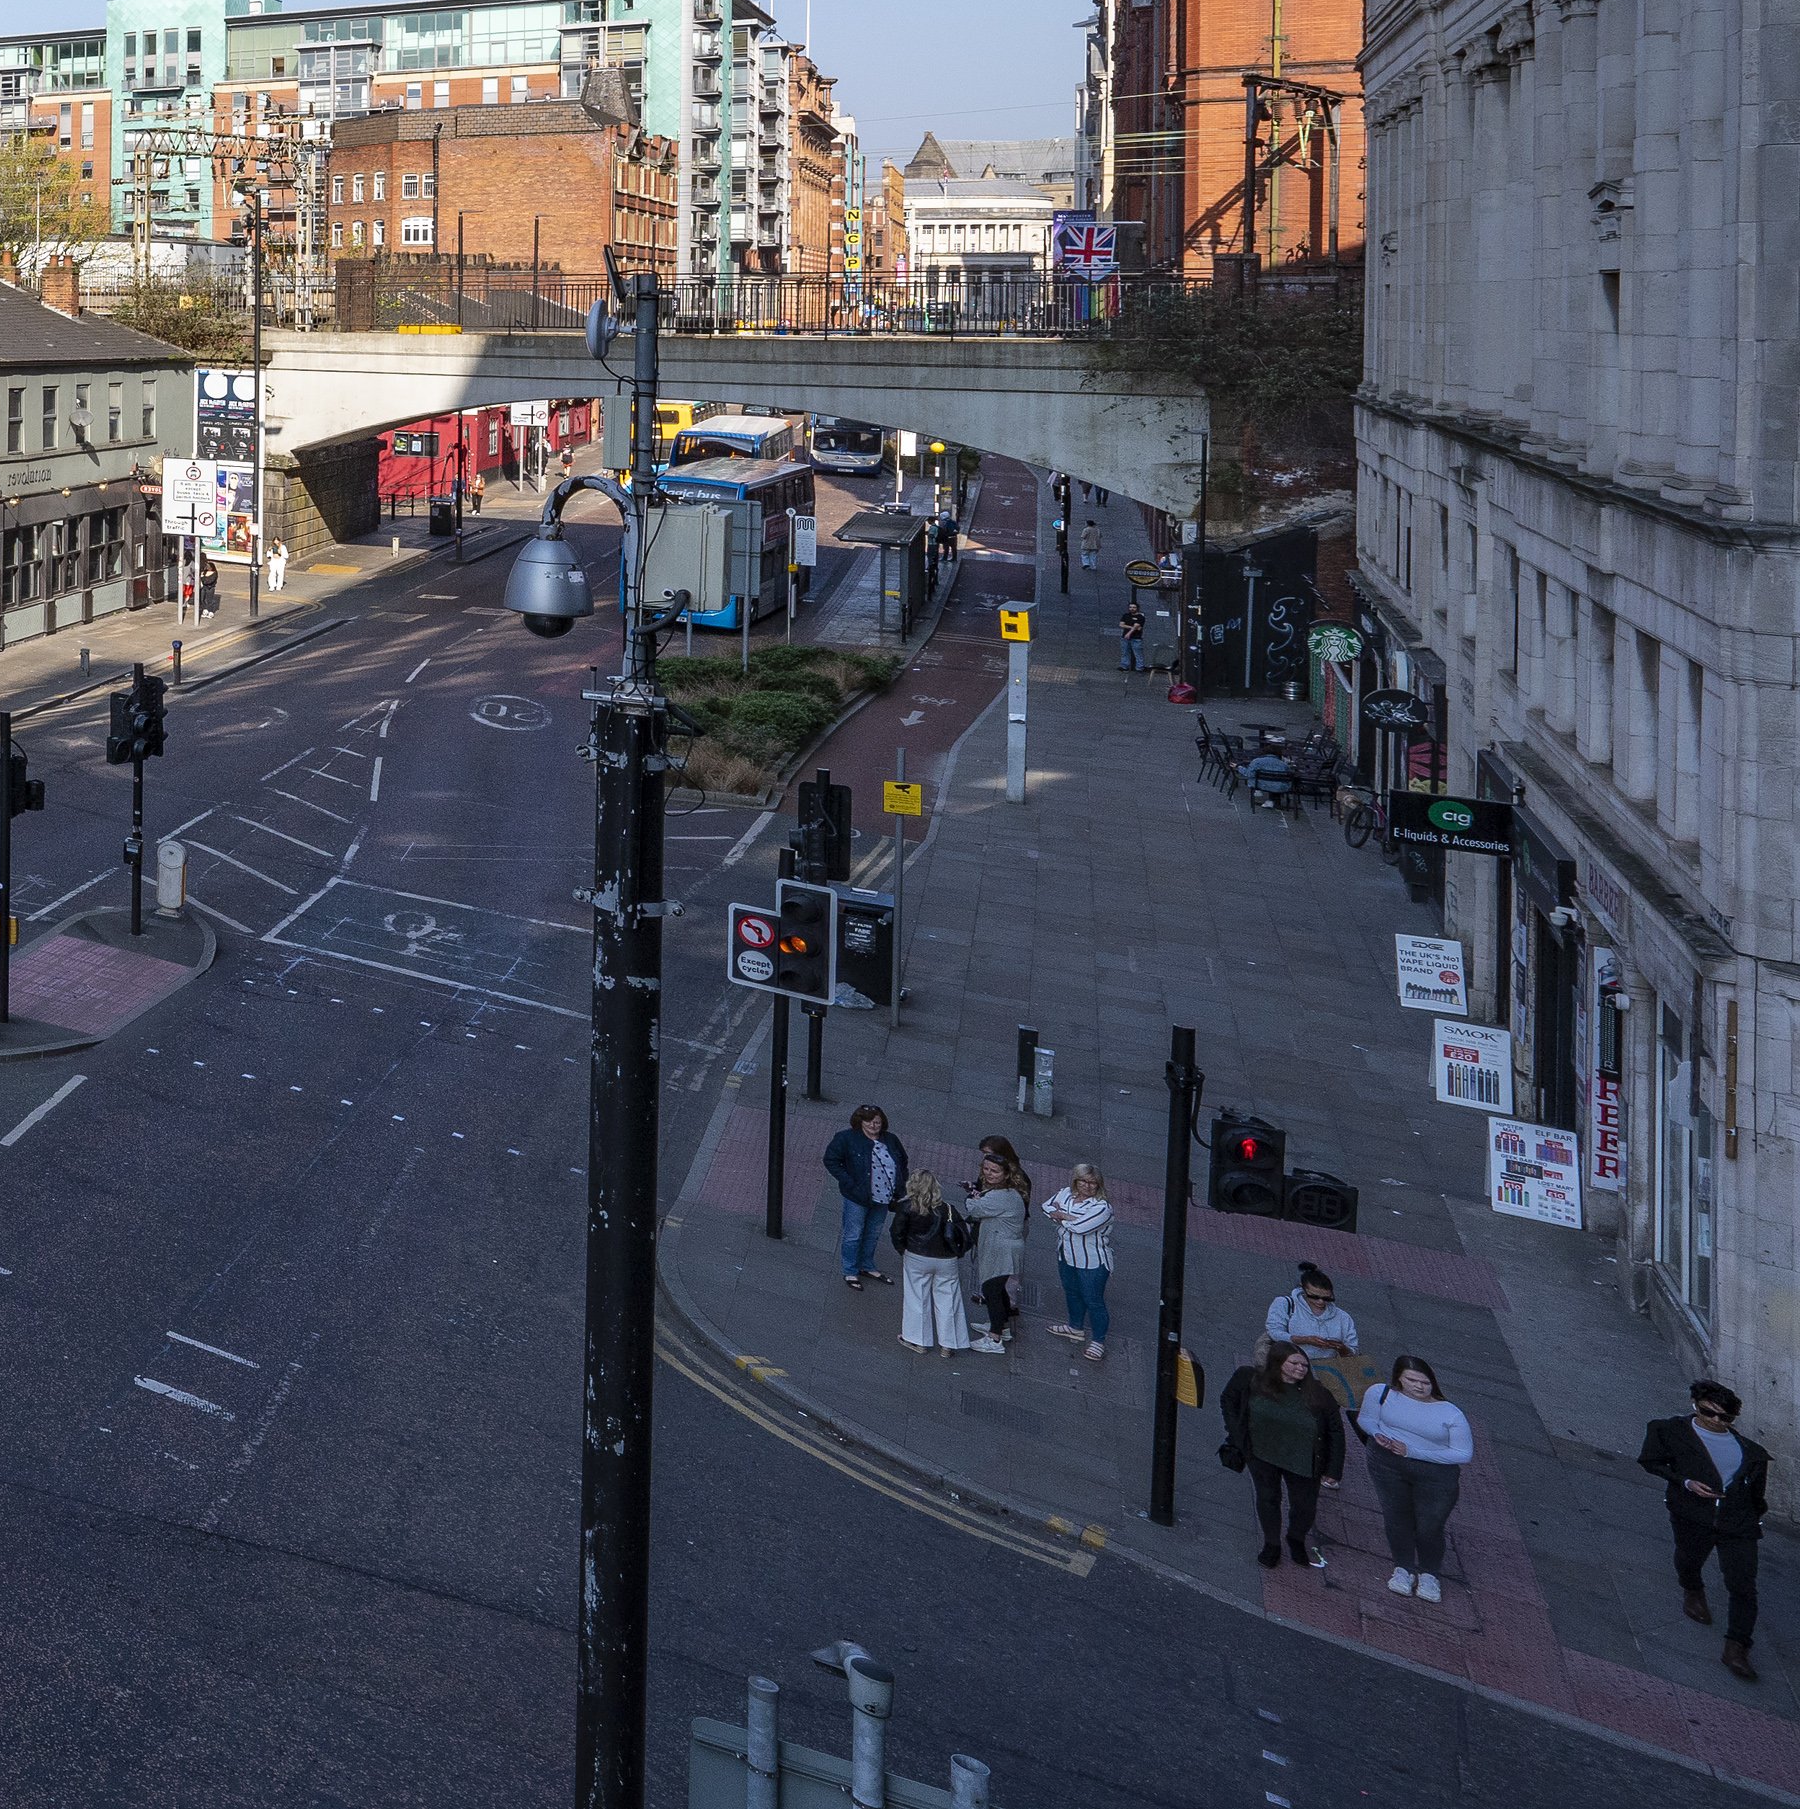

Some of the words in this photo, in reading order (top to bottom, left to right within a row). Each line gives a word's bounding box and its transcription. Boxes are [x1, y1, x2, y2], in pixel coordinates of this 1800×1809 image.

[7, 465, 52, 487] revolution
[1442, 810, 1472, 827] cig
[1393, 827, 1438, 844] E-liquids
[1440, 834, 1449, 844] &
[1452, 835, 1510, 852] Accessories
[1399, 949, 1417, 957] THE
[1419, 952, 1441, 960] UK'S
[741, 956, 771, 970] Except
[1400, 958, 1424, 966] VAPE
[1426, 961, 1459, 970] LIQUID
[742, 965, 770, 977] cycles
[1400, 965, 1433, 975] BRAND
[1444, 1026, 1498, 1043] SMOK
[1450, 1051, 1473, 1061] £20
[1554, 1133, 1573, 1141] BAR
[1556, 1184, 1574, 1192] MARY
